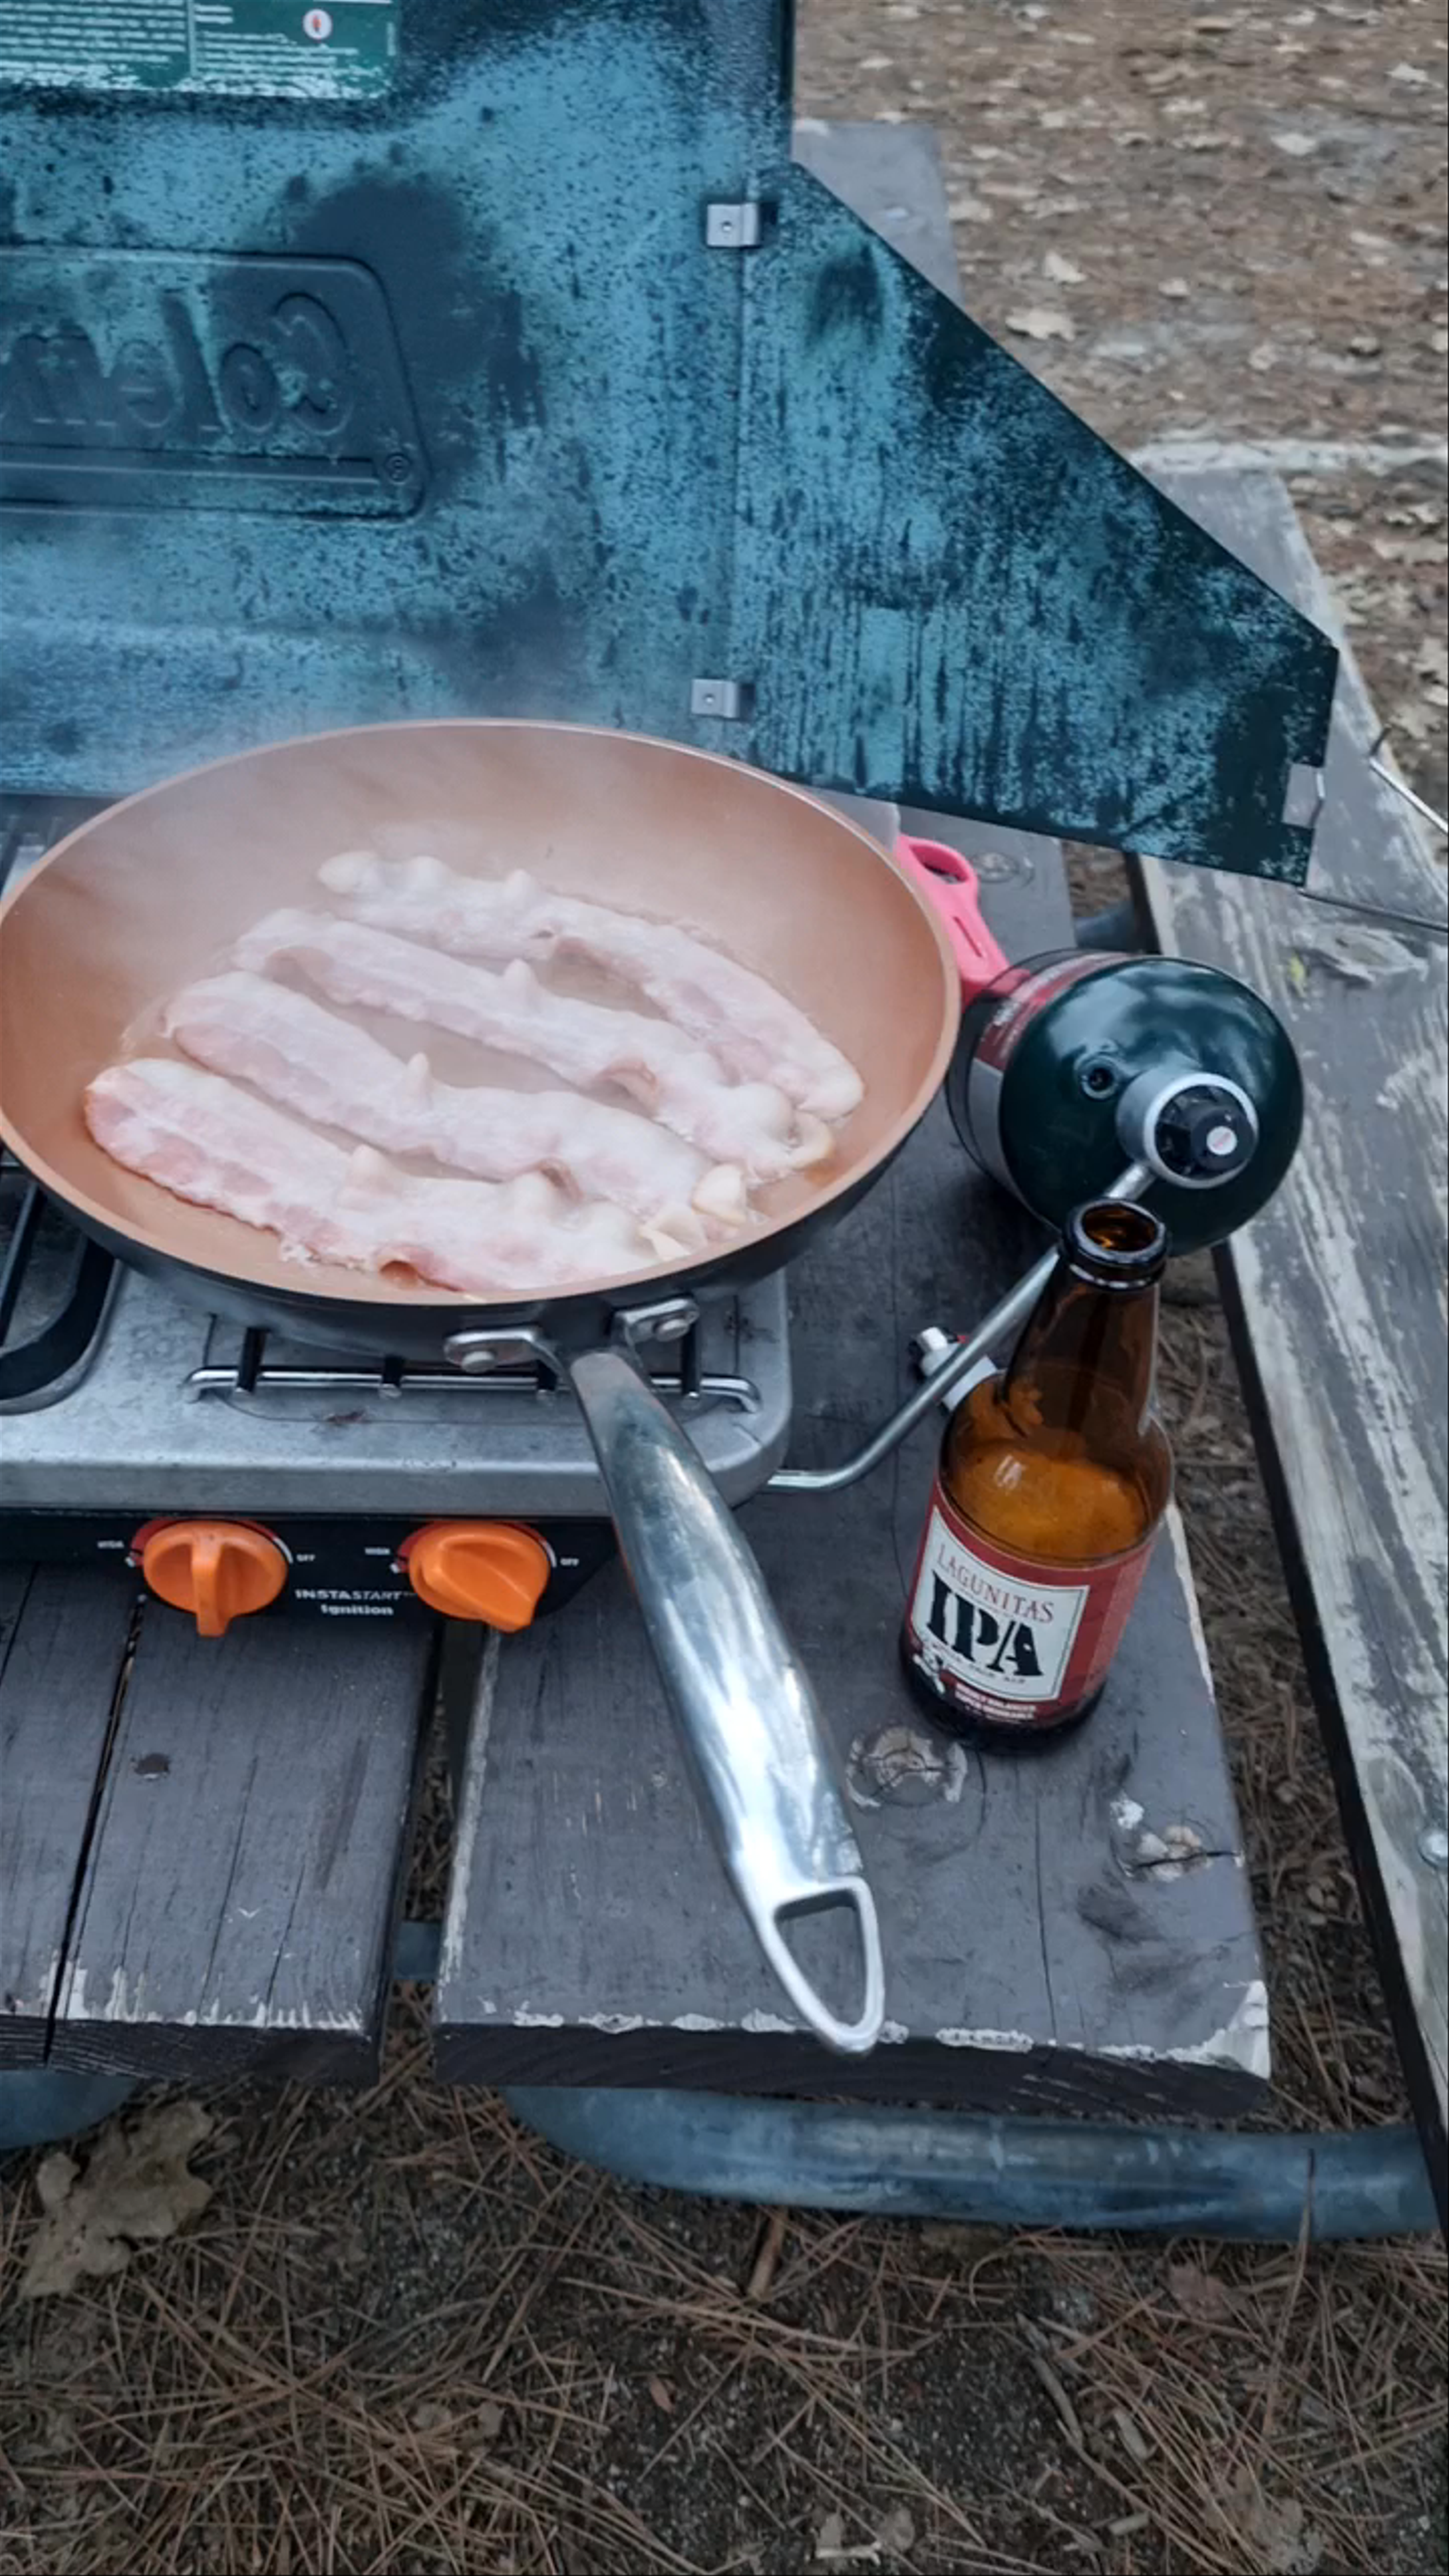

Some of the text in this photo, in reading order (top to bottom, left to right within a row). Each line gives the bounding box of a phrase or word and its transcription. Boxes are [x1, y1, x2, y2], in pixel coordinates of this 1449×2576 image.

[321, 1604, 394, 1615] Ignition
[926, 1569, 1044, 1676] IPA
[937, 1543, 1054, 1624] LAGUNITAS
